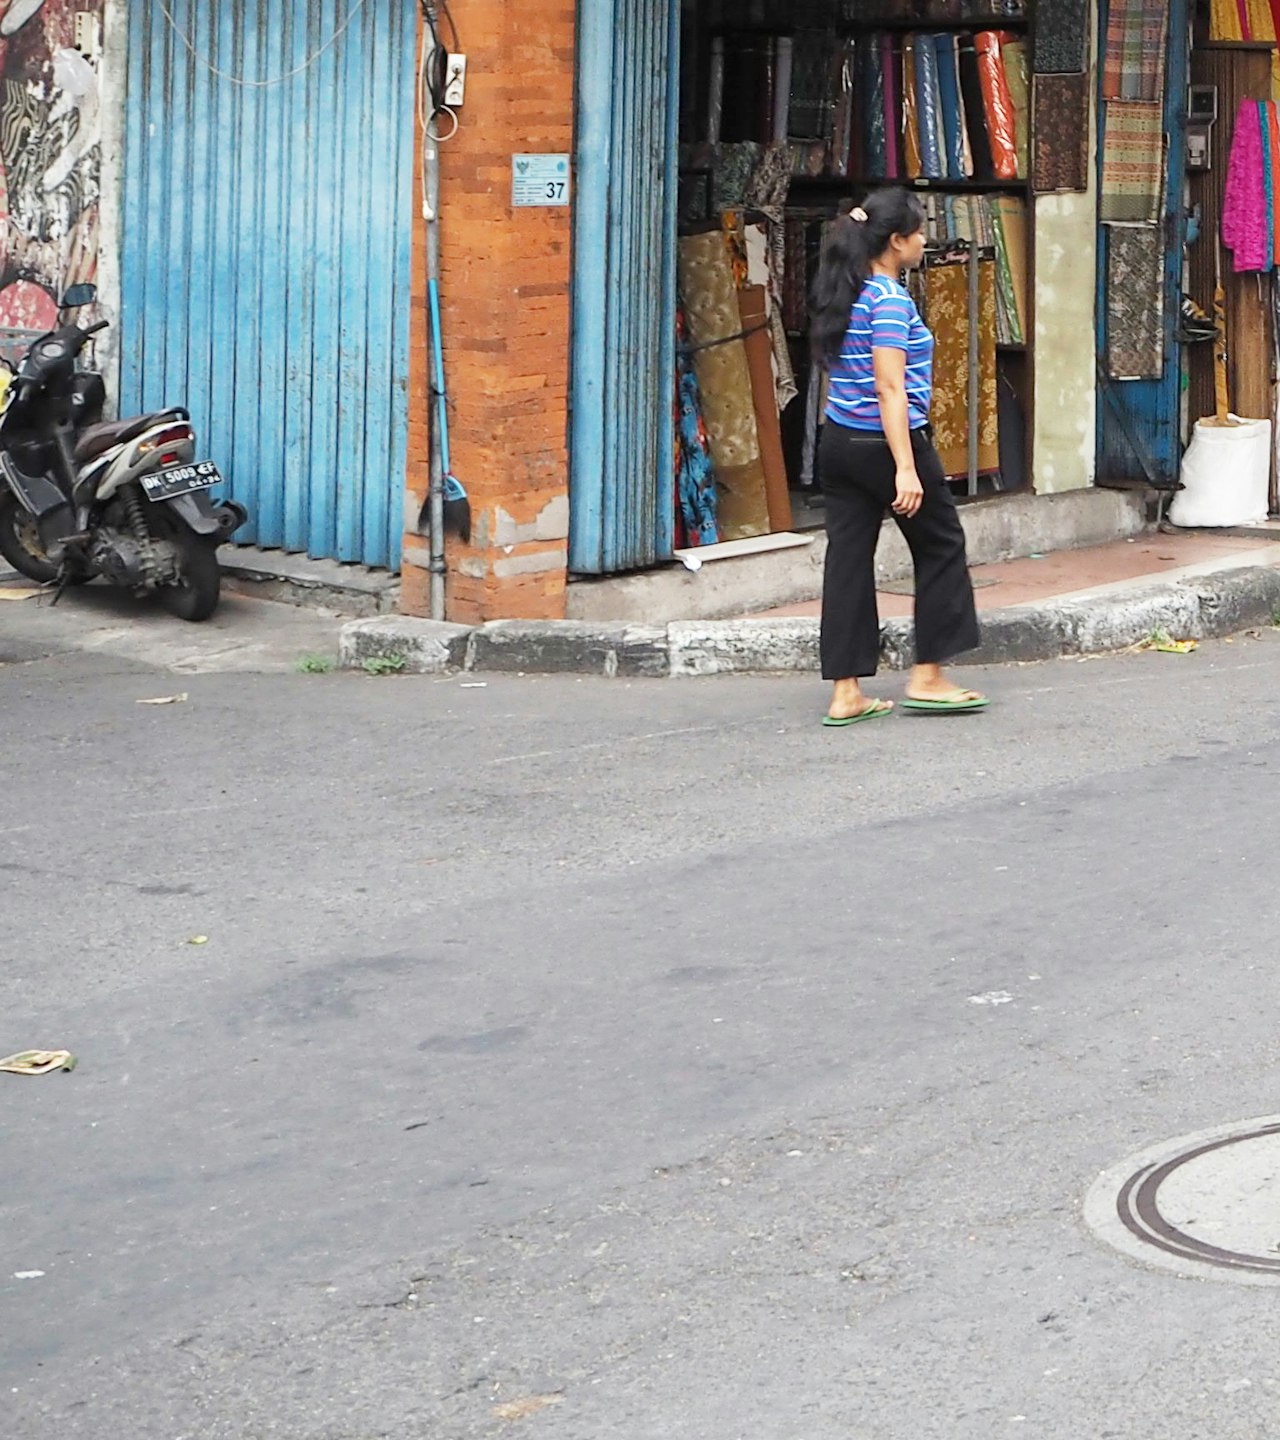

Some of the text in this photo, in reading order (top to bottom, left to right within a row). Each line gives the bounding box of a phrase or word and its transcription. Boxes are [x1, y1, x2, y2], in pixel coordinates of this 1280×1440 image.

[546, 181, 566, 199] 37
[143, 475, 162, 490] DK
[164, 466, 197, 484] 5009
